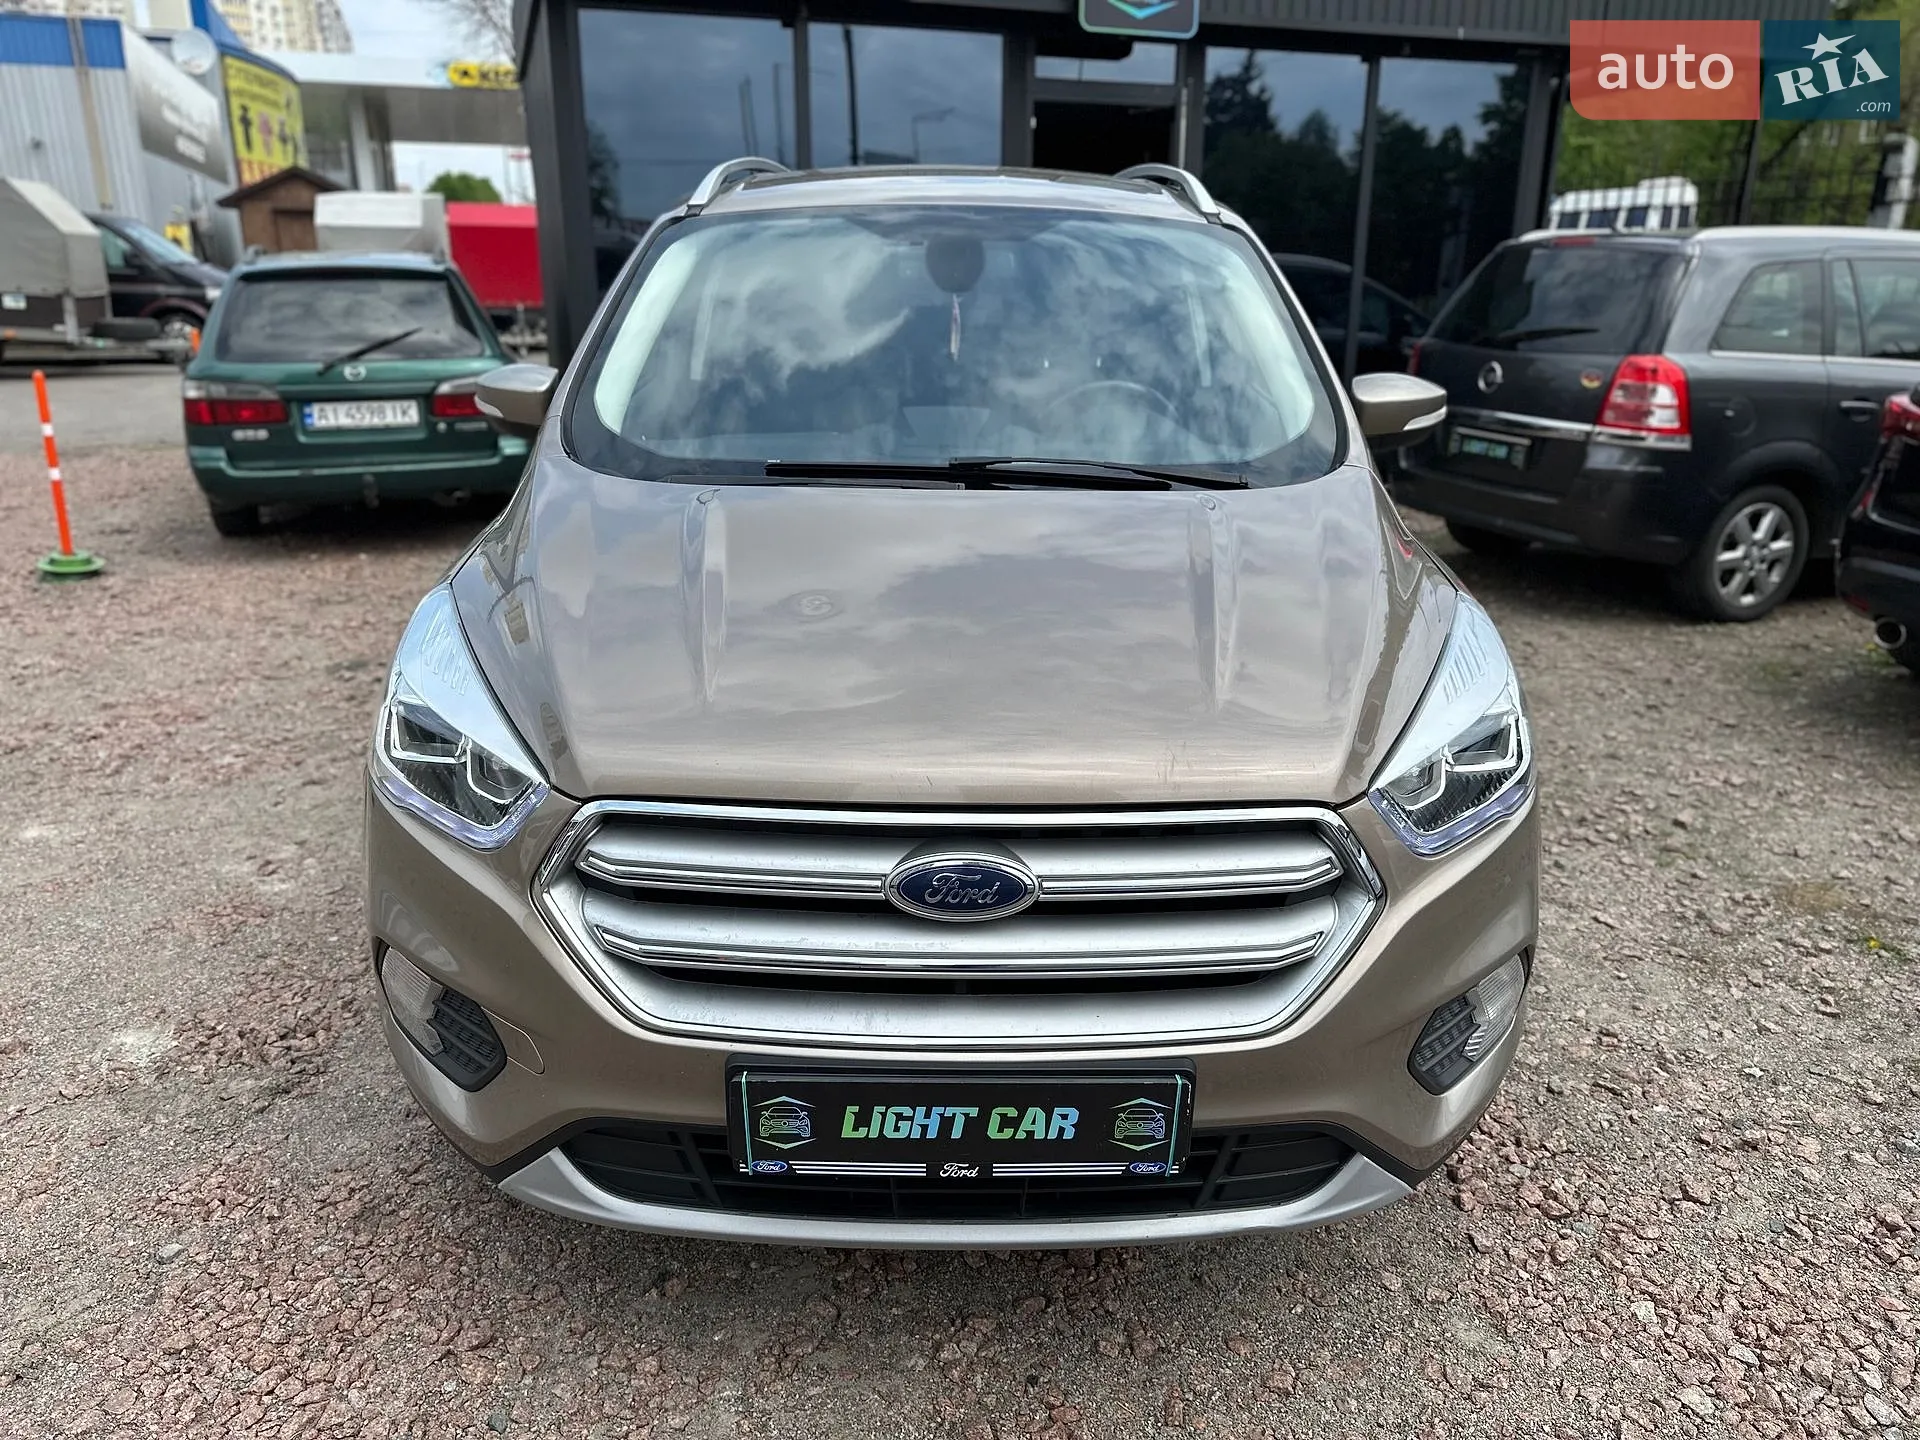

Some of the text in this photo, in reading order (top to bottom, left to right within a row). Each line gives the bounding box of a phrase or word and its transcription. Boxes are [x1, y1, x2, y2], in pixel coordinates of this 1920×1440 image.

[924, 872, 1001, 904] Ford
[841, 1106, 1080, 1140] LIGHT CAR
[757, 1160, 781, 1172] Ford
[939, 1162, 979, 1178] Ford
[1136, 1162, 1161, 1172] Ford
